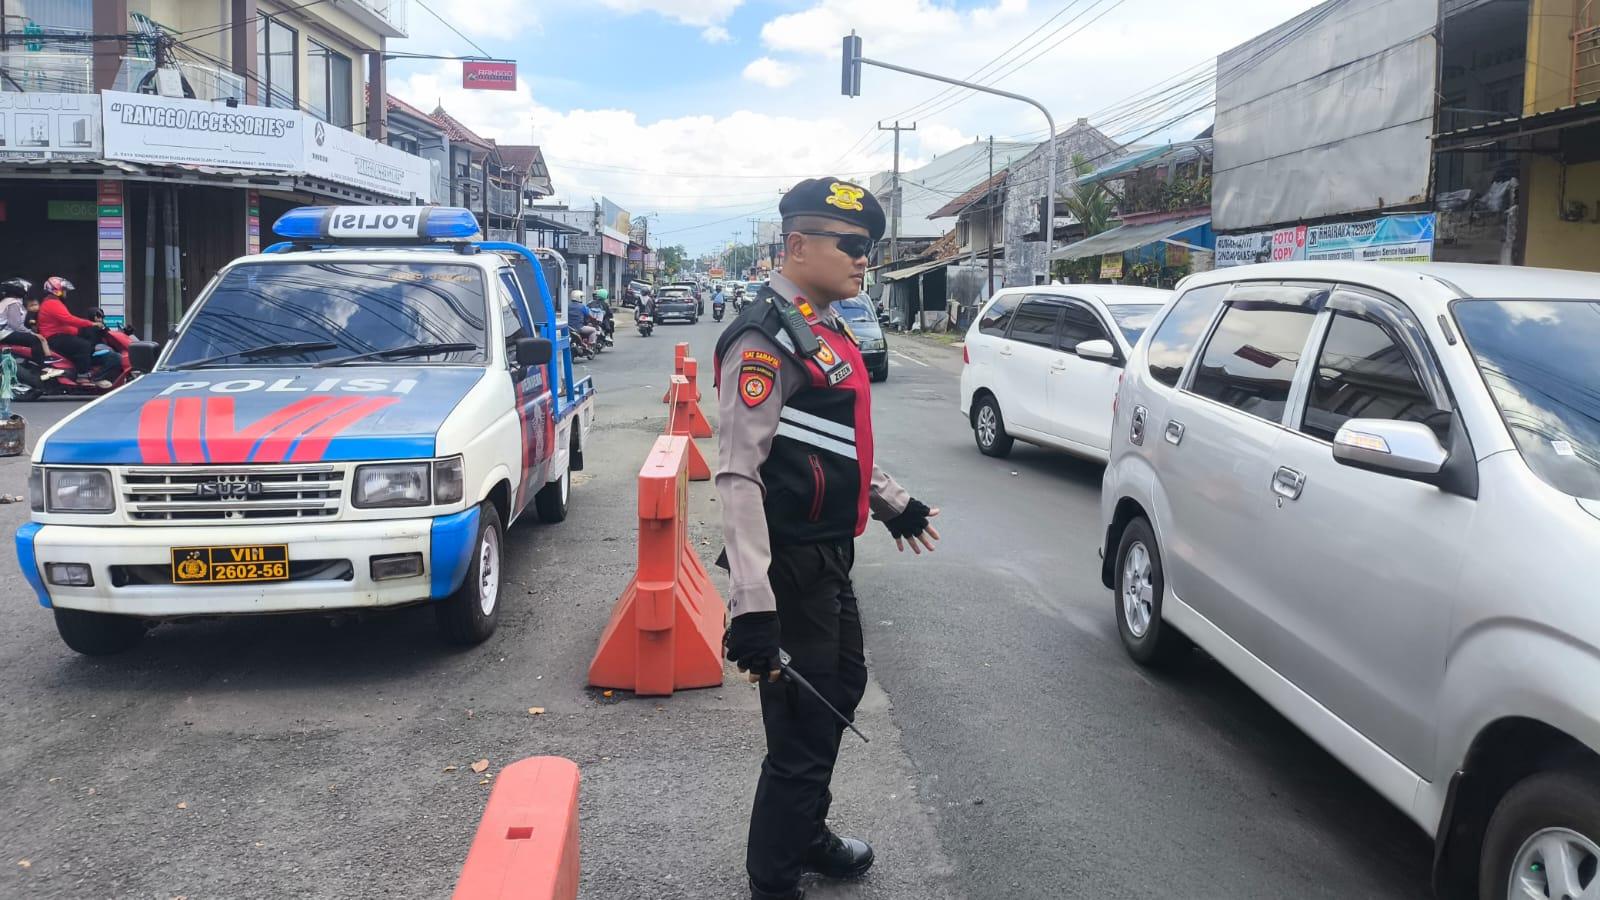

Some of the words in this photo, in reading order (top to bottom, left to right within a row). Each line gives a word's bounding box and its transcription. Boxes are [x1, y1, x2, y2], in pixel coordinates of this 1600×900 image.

[1274, 231, 1294, 244] FOTO
[1273, 247, 1293, 261] COPY
[835, 365, 851, 381] ZEZEN
[158, 377, 419, 396] POLISI
[197, 481, 264, 496] ISUZU
[215, 563, 284, 579] 2602-56
